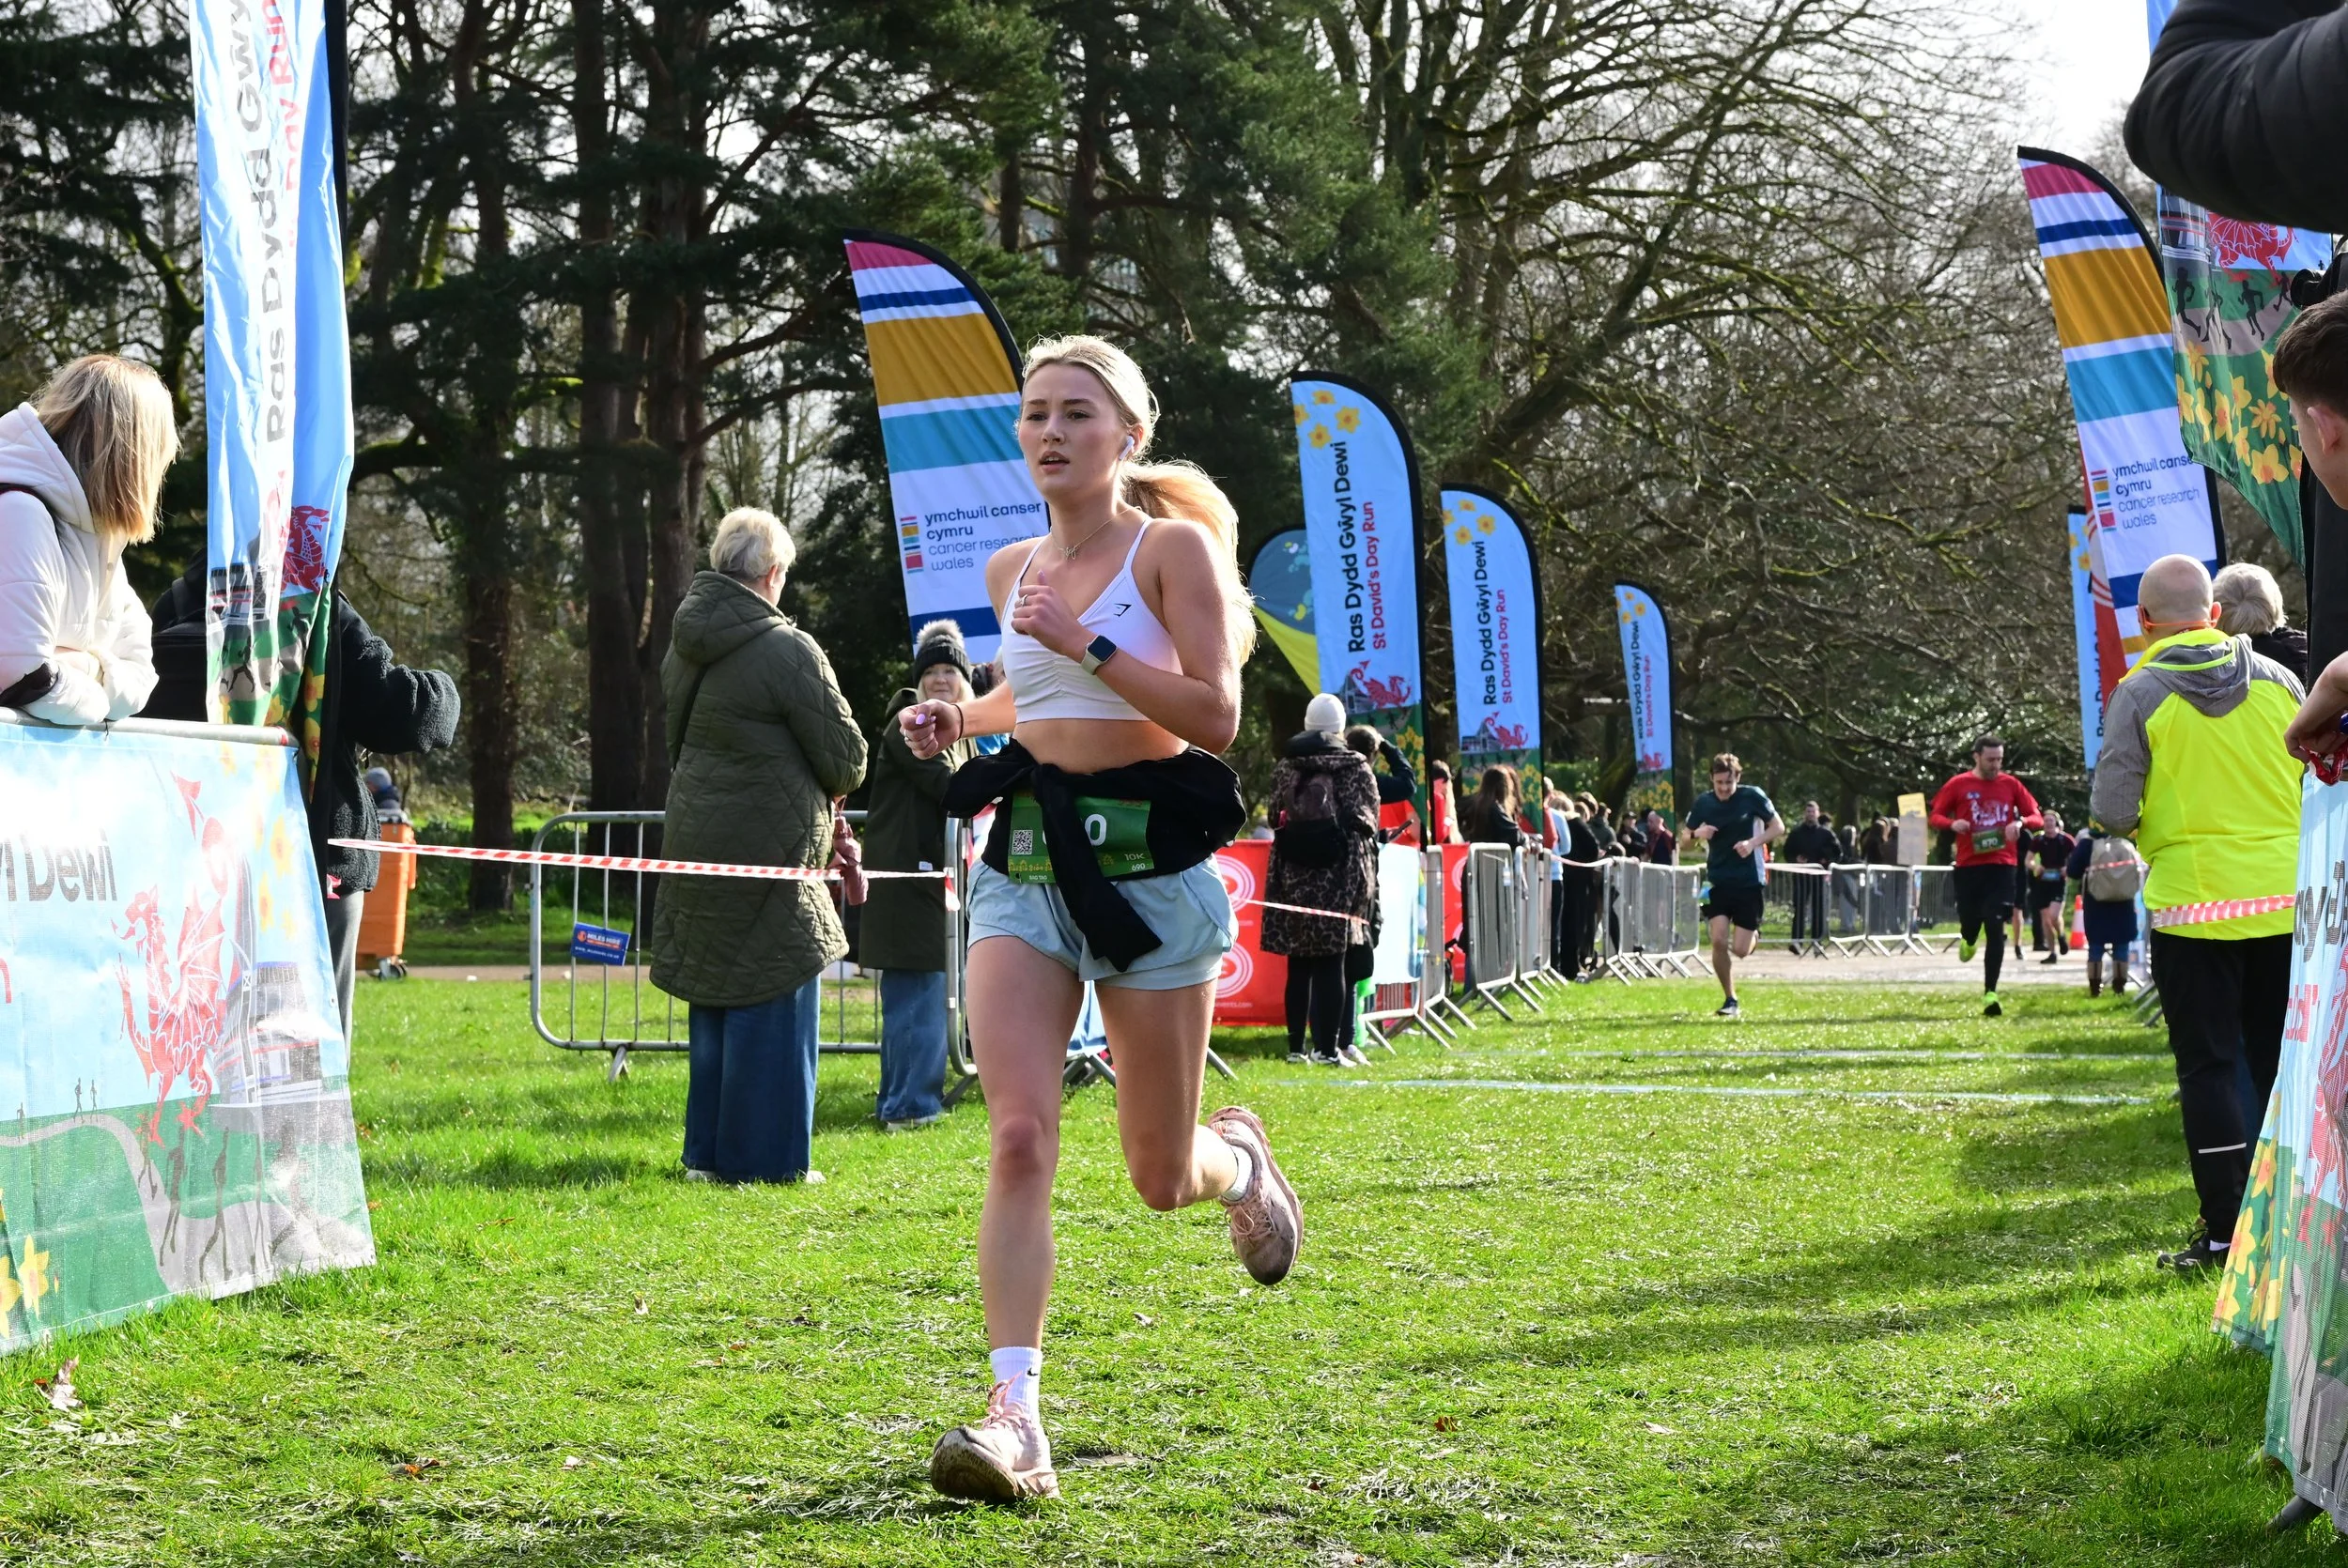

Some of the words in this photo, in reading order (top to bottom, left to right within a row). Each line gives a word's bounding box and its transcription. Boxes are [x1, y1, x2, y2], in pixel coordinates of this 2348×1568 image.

[246, 147, 285, 314] Dydd
[266, 328, 286, 443] Ras
[1330, 440, 1352, 493] Dewi
[2112, 457, 2159, 481] ymchwil
[2115, 479, 2153, 497] cymru
[2118, 496, 2157, 513] cancer
[2157, 486, 2201, 505] research
[924, 505, 988, 528] ymchwil
[991, 502, 1042, 517] canser
[1363, 501, 1376, 532] Run
[2122, 513, 2157, 530] wales
[926, 526, 974, 542] cymru
[928, 542, 978, 556] cancer
[1366, 535, 1380, 568] Day
[1472, 541, 1488, 580] Dewi
[931, 558, 974, 572] wales
[1342, 553, 1365, 609] Dydd
[1367, 570, 1385, 630] David's
[1496, 590, 1506, 612] Run
[1348, 613, 1366, 653] Ras
[1373, 632, 1386, 650] St
[1499, 615, 1509, 640] Day
[1479, 628, 1497, 671] Dydd
[1500, 642, 1511, 687] David's
[1484, 675, 1497, 704] Ras
[1503, 691, 1512, 703] St
[1635, 684, 1644, 715] Dydd
[19, 825, 117, 902] Dewi
[1124, 853, 1146, 861] 10K
[1131, 863, 1146, 871] 690
